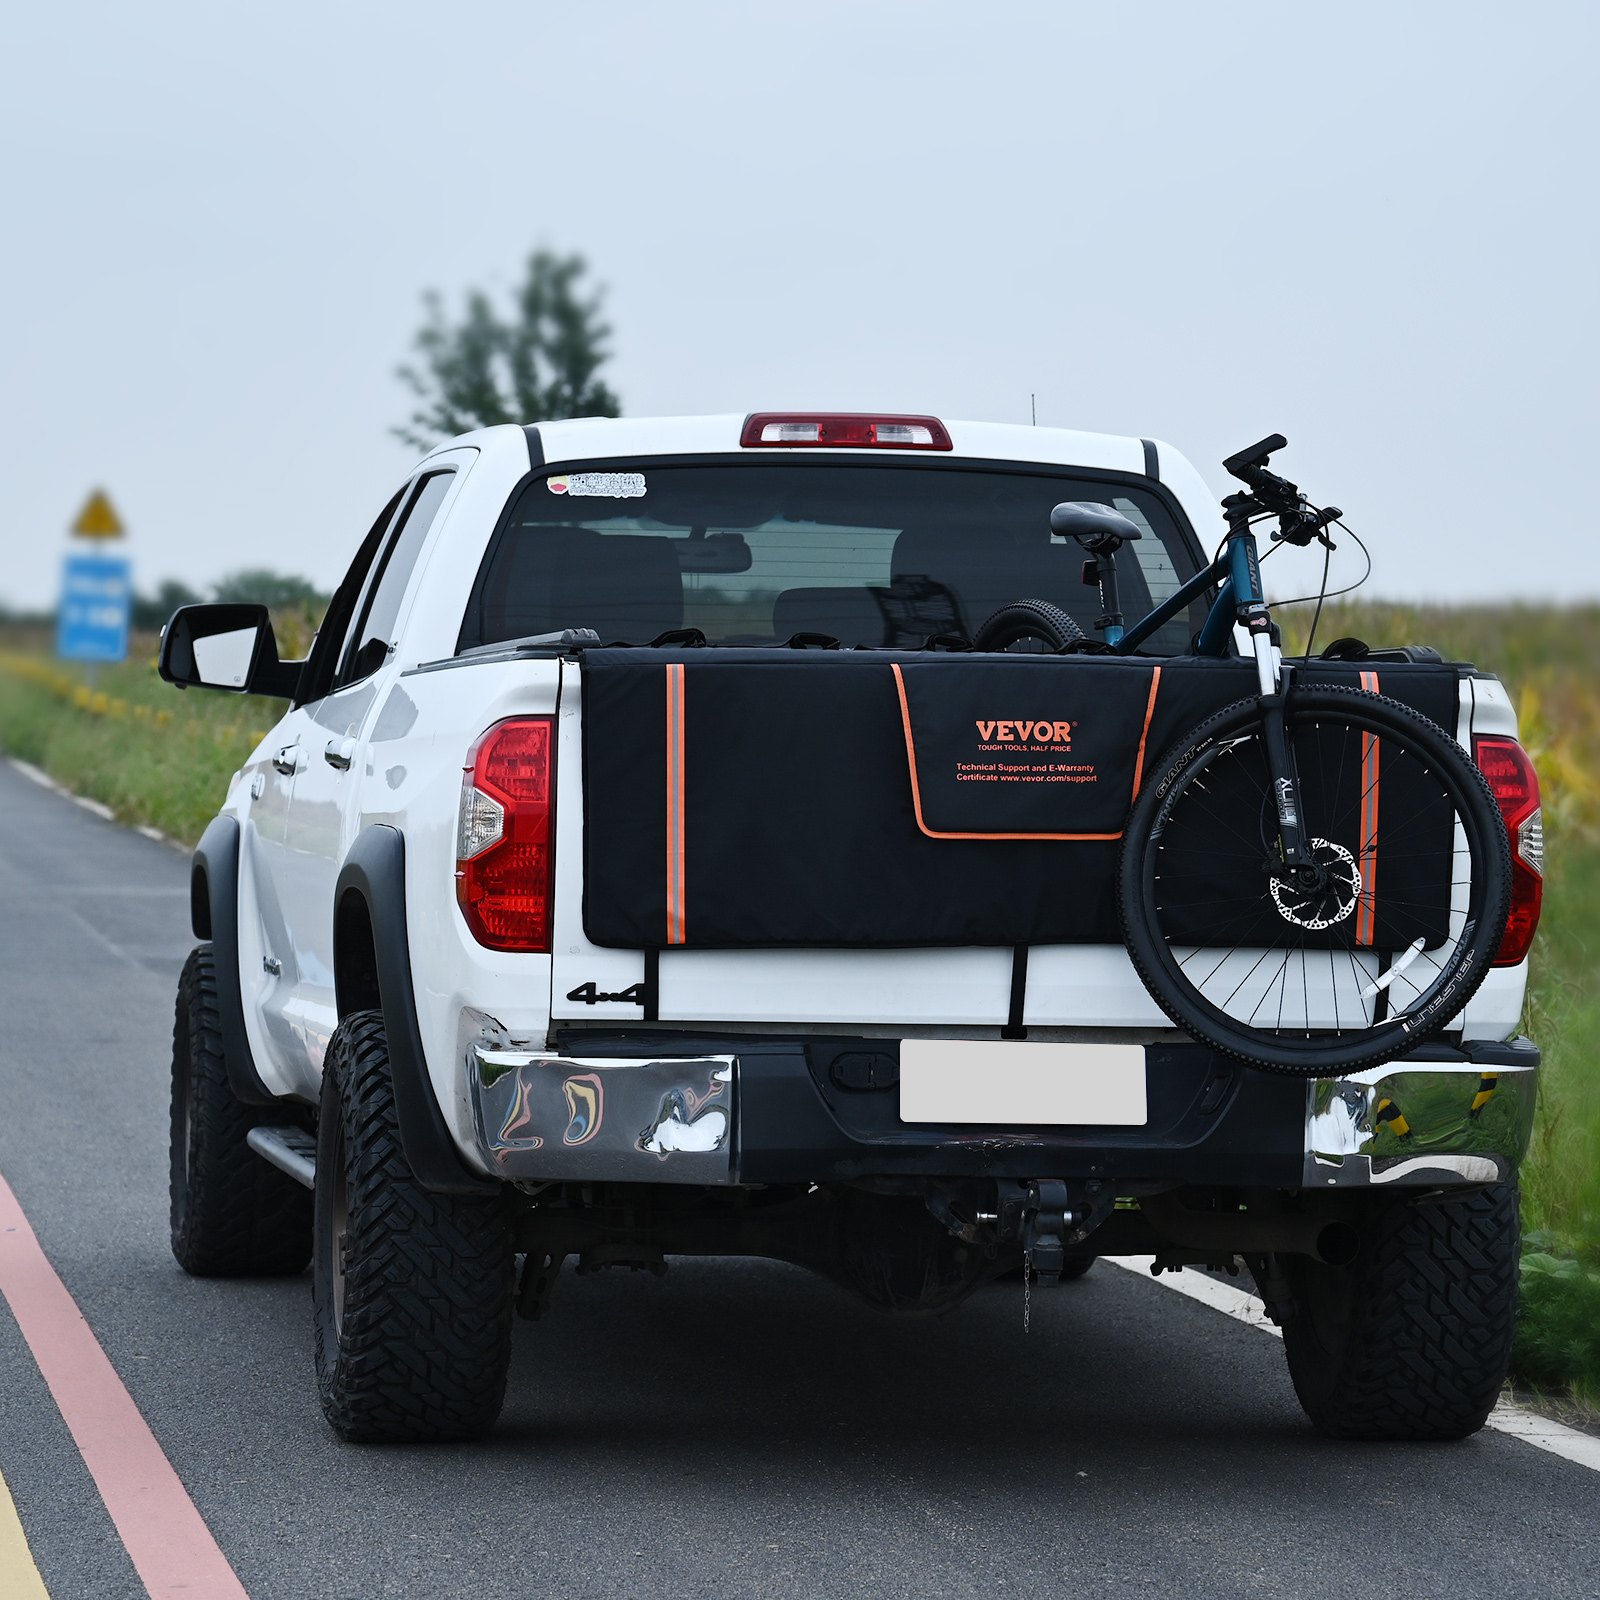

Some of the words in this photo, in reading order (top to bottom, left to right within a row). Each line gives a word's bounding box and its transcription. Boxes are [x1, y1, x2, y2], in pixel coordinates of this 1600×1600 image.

[1245, 544, 1260, 593] GIANT
[975, 720, 1072, 743] VEVOR
[956, 762, 996, 771] Technical
[998, 763, 1030, 773] Support
[1031, 764, 1047, 772] and
[1049, 764, 1095, 773] E-Warranty
[956, 773, 999, 782] Certificate
[1000, 774, 1098, 783] www.vevor.com/support
[1155, 745, 1196, 799] GIANT
